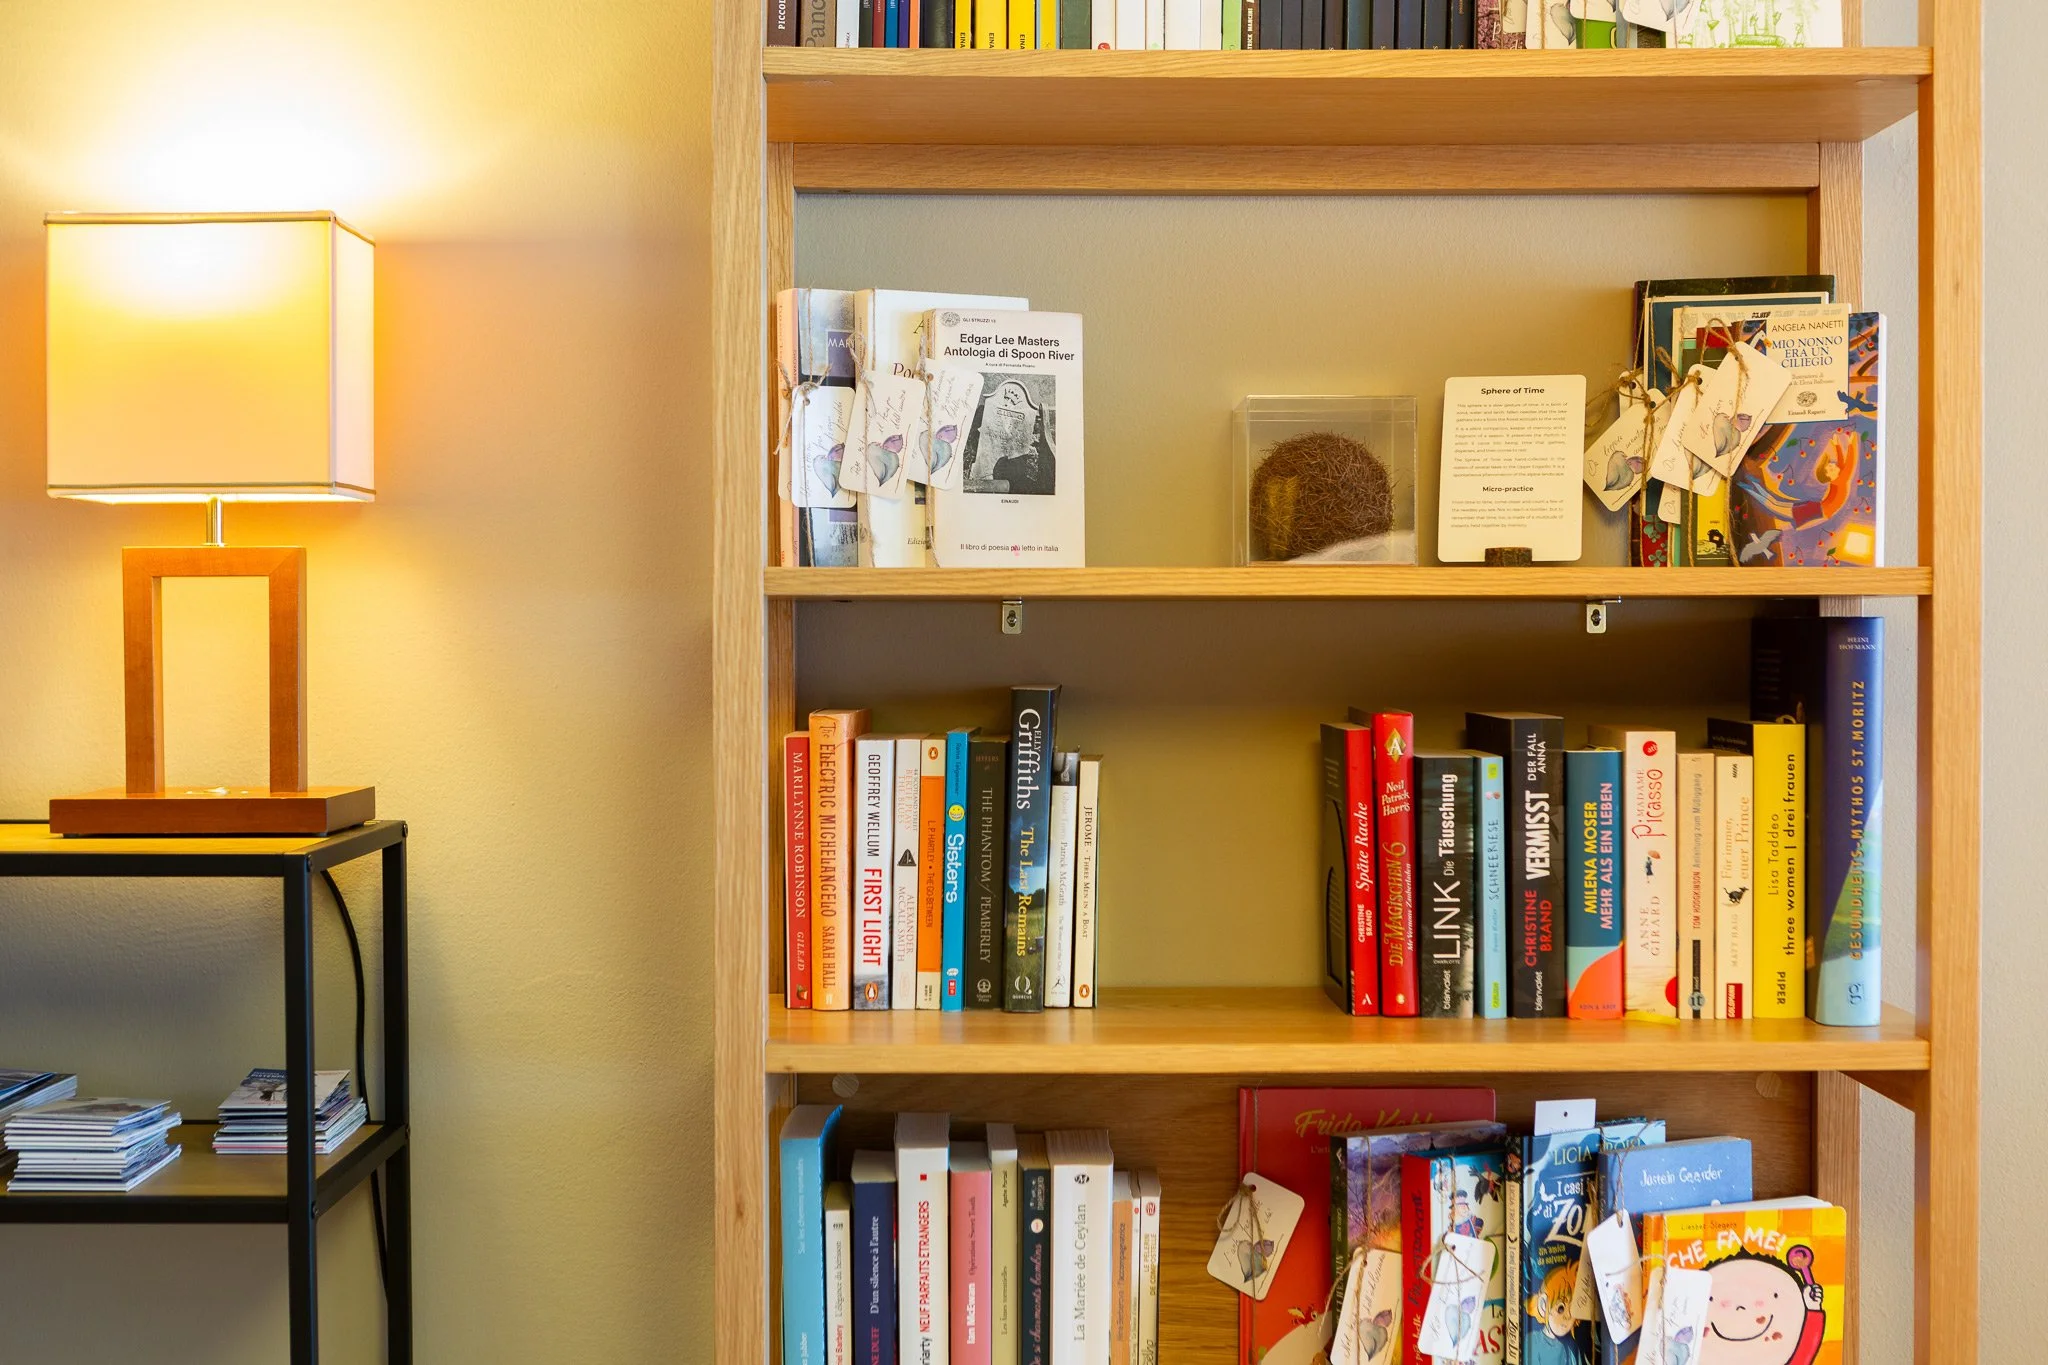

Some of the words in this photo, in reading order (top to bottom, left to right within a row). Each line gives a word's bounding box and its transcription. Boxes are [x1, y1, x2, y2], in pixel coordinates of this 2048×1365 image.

[960, 333, 993, 347] Edgar
[995, 335, 1015, 346] Lee
[1017, 336, 1061, 348] Masters
[1771, 322, 1806, 333] ANGELA
[1808, 320, 1845, 331] NANETTI
[1772, 339, 1795, 350] MIO
[1797, 335, 1844, 348] NONNO
[943, 346, 997, 359] Antologia
[998, 348, 1009, 358] di
[1011, 348, 1046, 361] Spoon
[1048, 350, 1076, 362] River
[1780, 356, 1834, 369] CILIEGIO
[1784, 348, 1808, 359] ERA
[1811, 346, 1830, 357] UN
[1481, 387, 1511, 395] Sphere
[1482, 486, 1534, 494] Micro-practice
[988, 545, 1010, 553] poesia
[1033, 730, 1042, 752] ELLY
[1526, 732, 1537, 758] FALL
[1536, 740, 1547, 774] ANNA
[818, 743, 836, 809] ELECTRIC
[1016, 708, 1042, 810] Griffiths
[1527, 760, 1538, 782] DER
[867, 753, 881, 809] GEOFFREY
[1386, 779, 1405, 794] Neil
[1635, 768, 1646, 819] MADAME
[1782, 753, 1796, 803] frauen
[793, 752, 804, 841] MARILYNNE
[980, 787, 993, 811] THE
[1381, 790, 1410, 806] Patrick
[1599, 781, 1613, 826] LEBEN
[1631, 768, 1668, 840] Picasso
[1083, 806, 1093, 847] JEROME
[1353, 801, 1369, 848] Rache
[1438, 773, 1459, 858] Täuschung
[1583, 801, 1598, 855] MOSER
[1693, 815, 1702, 831] zum
[1735, 795, 1750, 844] Prince
[1782, 807, 1796, 838] drei
[866, 811, 880, 857] WELLUM
[926, 835, 937, 863] HARTLEY
[980, 815, 994, 880] PHANTOM
[1020, 826, 1035, 856] The
[1381, 840, 1407, 858] 6
[1524, 789, 1551, 881] VERMISST
[1599, 829, 1613, 854] EIN
[1691, 832, 1703, 868] Anleitung
[1721, 817, 1734, 857] immer,
[1766, 813, 1779, 864] Taddeo
[817, 814, 837, 917] MICHELANGELO
[946, 833, 965, 904] Sisters
[1058, 841, 1069, 868] Patrick
[1354, 850, 1374, 893] Späte
[1443, 860, 1455, 877] Die
[1487, 818, 1500, 901] SCHNEERIESE
[1600, 857, 1613, 885] ALS
[1721, 858, 1733, 880] Für
[1739, 848, 1750, 881] euer
[1849, 775, 1865, 961] GESUNDHEITS-MYTHOS
[794, 845, 806, 919] ROBINSON
[863, 867, 882, 915] FIRST
[1018, 860, 1033, 890] Last
[1057, 871, 1068, 906] McGrath
[1583, 857, 1598, 915] MILENA
[1692, 870, 1702, 914] HODGKINSON
[1767, 869, 1779, 896] Lisa
[1785, 856, 1796, 912] women
[906, 894, 916, 955] ALEXANDER
[1016, 894, 1033, 957] Remains
[1357, 903, 1365, 943] CHRISTINE
[1365, 909, 1373, 936] BRAND
[1433, 880, 1461, 959] LINK
[1539, 899, 1553, 952] BRAND
[1600, 888, 1614, 931] MEHR
[1650, 895, 1661, 957] GIRARD
[1692, 915, 1702, 930] TOM
[1730, 913, 1739, 939] HAIG
[822, 926, 836, 959] SARAH
[863, 919, 882, 967] LIGHT
[896, 928, 906, 963] SMITH
[978, 896, 993, 963] PEMBERLEY
[1524, 889, 1538, 968] CHRISTINE
[1639, 906, 1650, 951] ANNE
[1783, 916, 1796, 956] three
[796, 931, 805, 971] GILEAD
[1730, 942, 1739, 967] MATT
[822, 962, 836, 989] HALL
[1442, 969, 1452, 1010] blanvalet
[1534, 970, 1543, 1011] blanvalet
[1776, 970, 1787, 1005] PIPER
[1727, 984, 1736, 1019] GOLDMANN
[1552, 1146, 1593, 1166] LICIA
[1564, 1179, 1585, 1196] casi
[1639, 1168, 1677, 1188] Jostein
[1073, 1203, 1089, 1251] Ceylan
[1542, 1203, 1554, 1219] di
[869, 1216, 880, 1247] l'autre
[1667, 1239, 1707, 1270] CHE
[1716, 1226, 1788, 1252] FAME!
[869, 1253, 880, 1289] silence
[1074, 1253, 1087, 1270] de
[918, 1260, 931, 1305] PARFAITS
[1073, 1273, 1087, 1321] Mariée
[869, 1290, 880, 1315] D'un
[919, 1307, 931, 1333] NEUF
[966, 1282, 976, 1327] McEwan
[870, 1326, 880, 1353] DUFF
[966, 1327, 976, 1345] Ian
[1073, 1324, 1086, 1342] La
